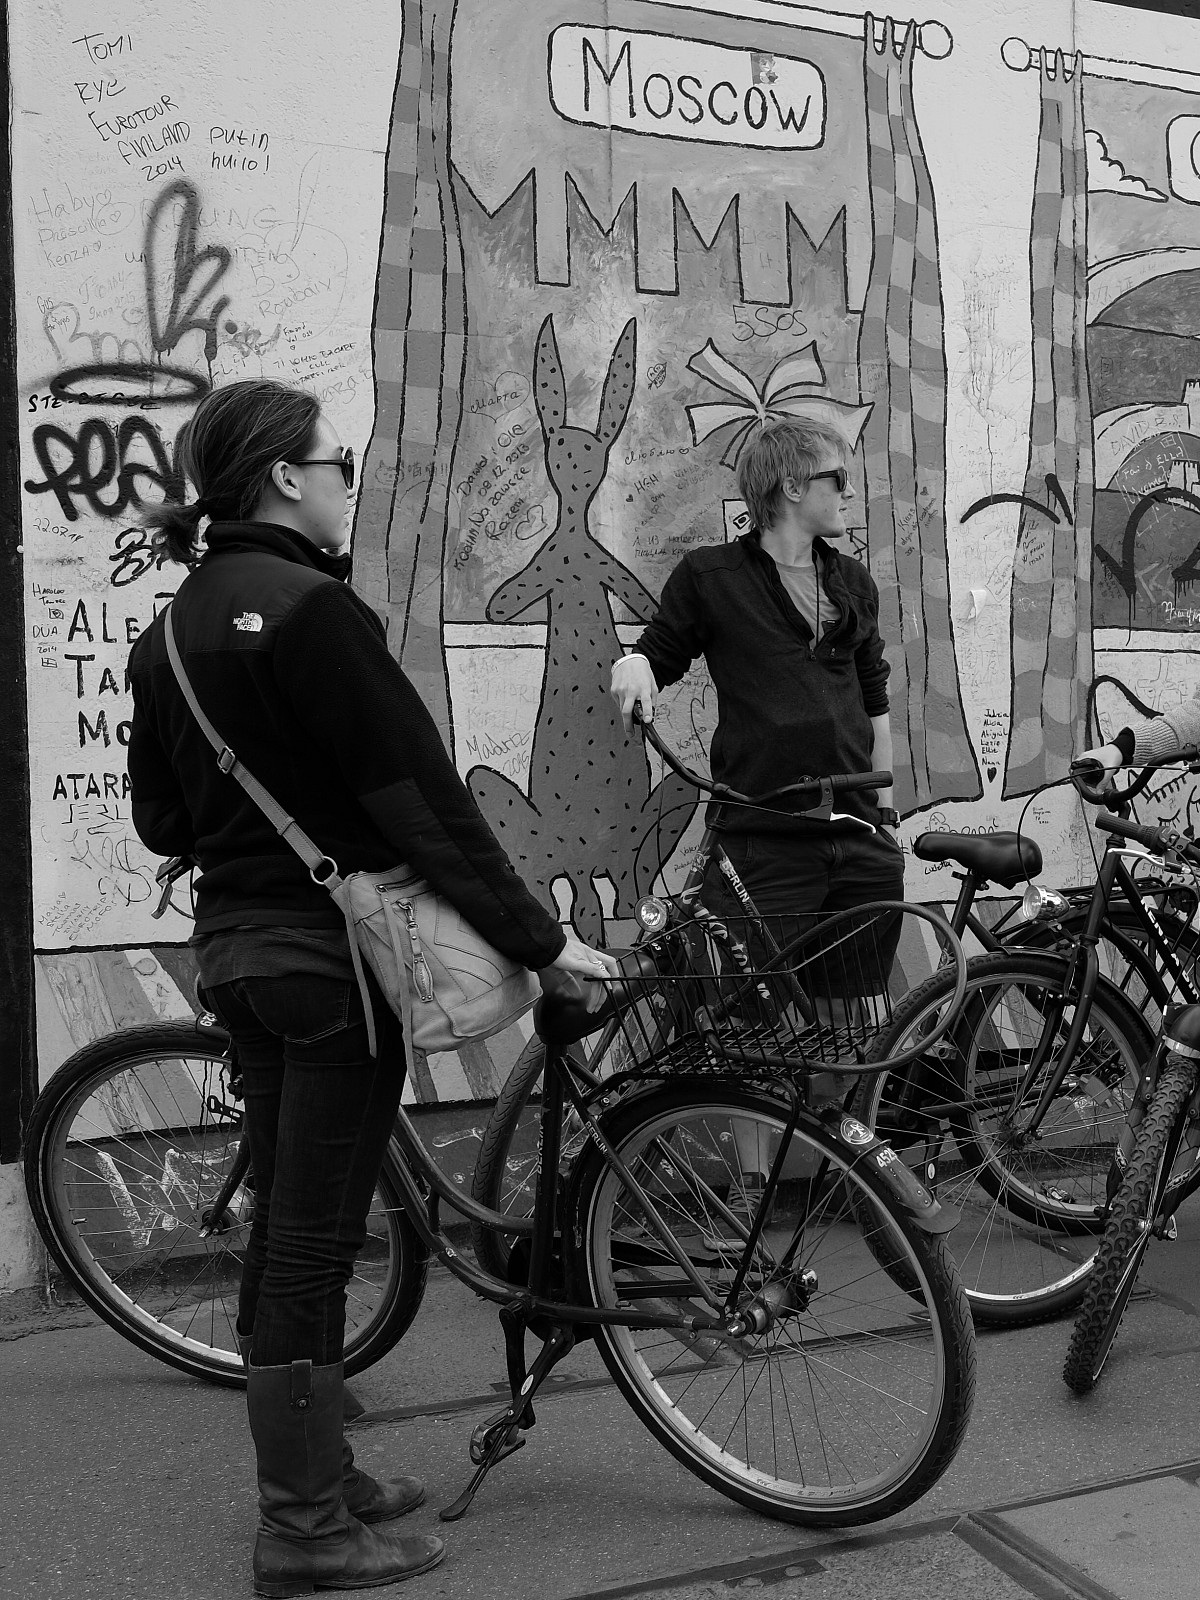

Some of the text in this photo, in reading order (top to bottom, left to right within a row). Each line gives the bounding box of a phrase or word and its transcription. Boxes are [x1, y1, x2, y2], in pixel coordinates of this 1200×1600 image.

[141, 157, 187, 181] 2014
[721, 859, 750, 903] BERLIN
[585, 1120, 608, 1155] BERLIN
